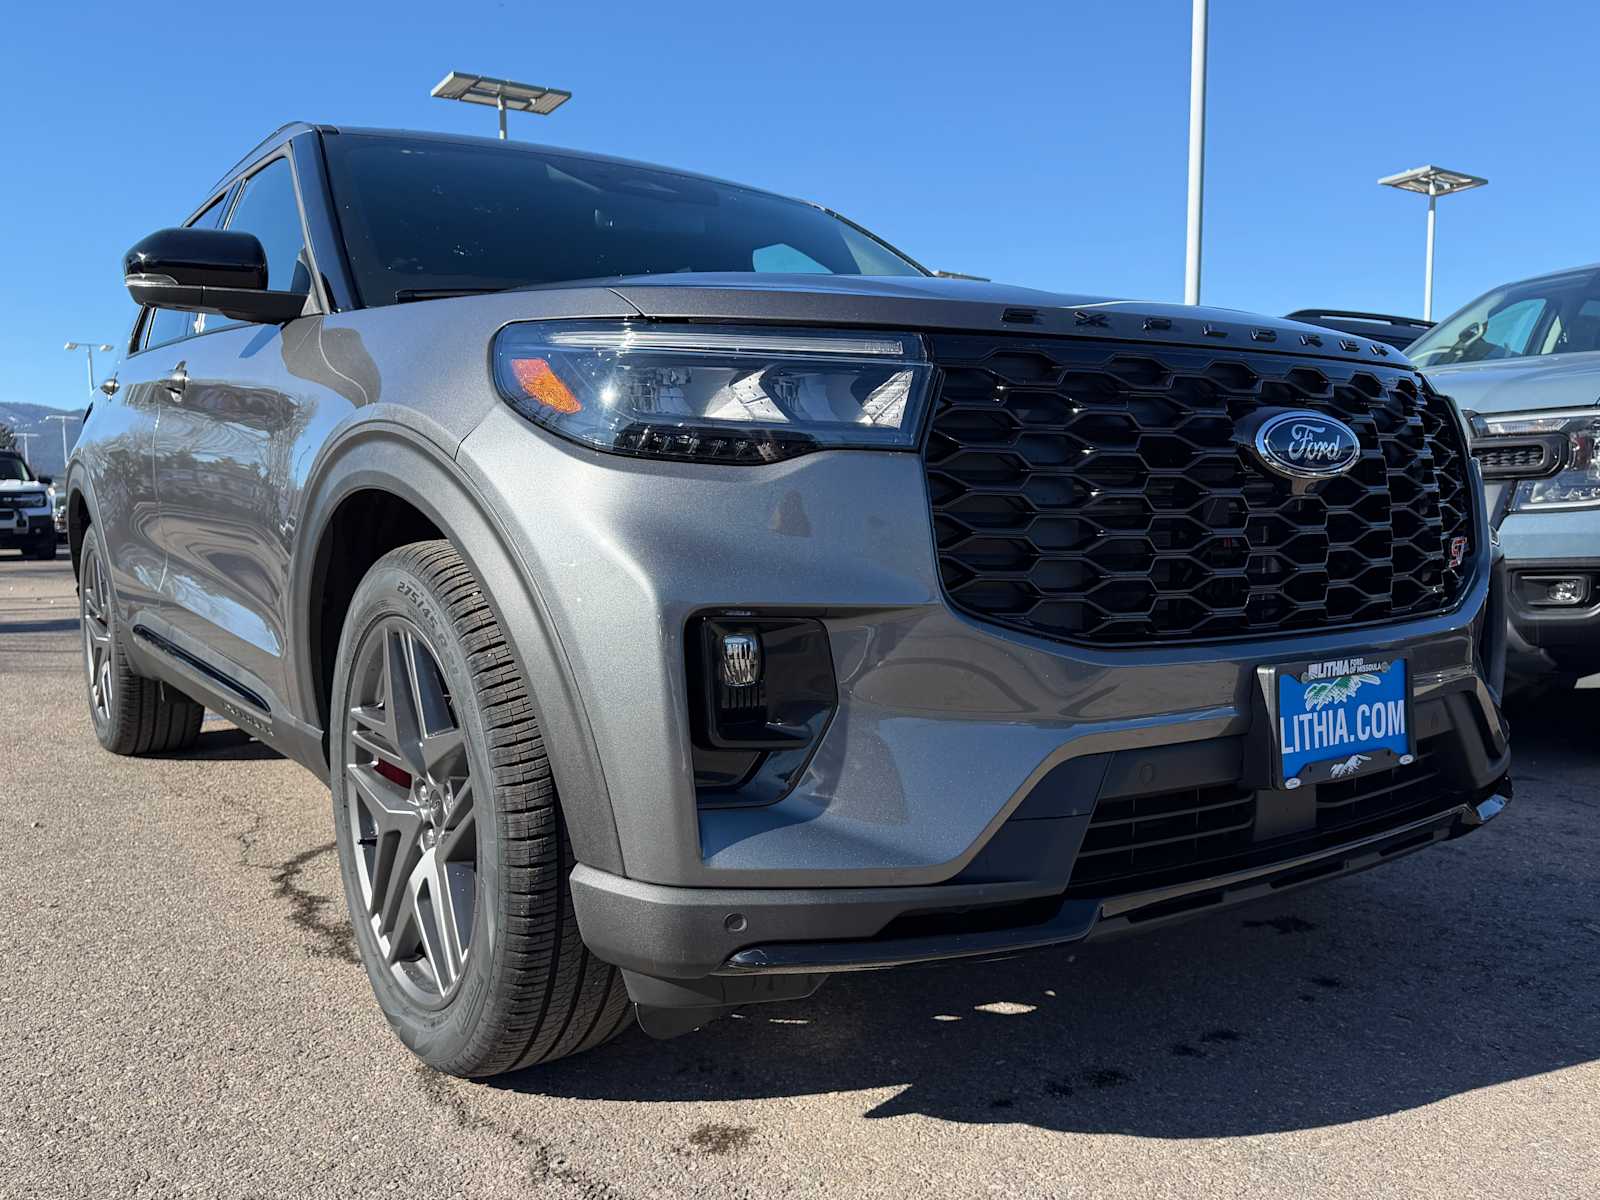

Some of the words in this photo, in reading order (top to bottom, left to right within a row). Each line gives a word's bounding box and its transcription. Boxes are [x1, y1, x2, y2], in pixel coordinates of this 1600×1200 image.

[1001, 307, 1389, 357] EXPLORER
[1289, 424, 1342, 461] Ford
[1318, 659, 1350, 678] LITHIA
[1350, 658, 1364, 666] FORD
[1357, 663, 1381, 673] MISSOULA
[1280, 700, 1405, 754] LITHIA.COM
